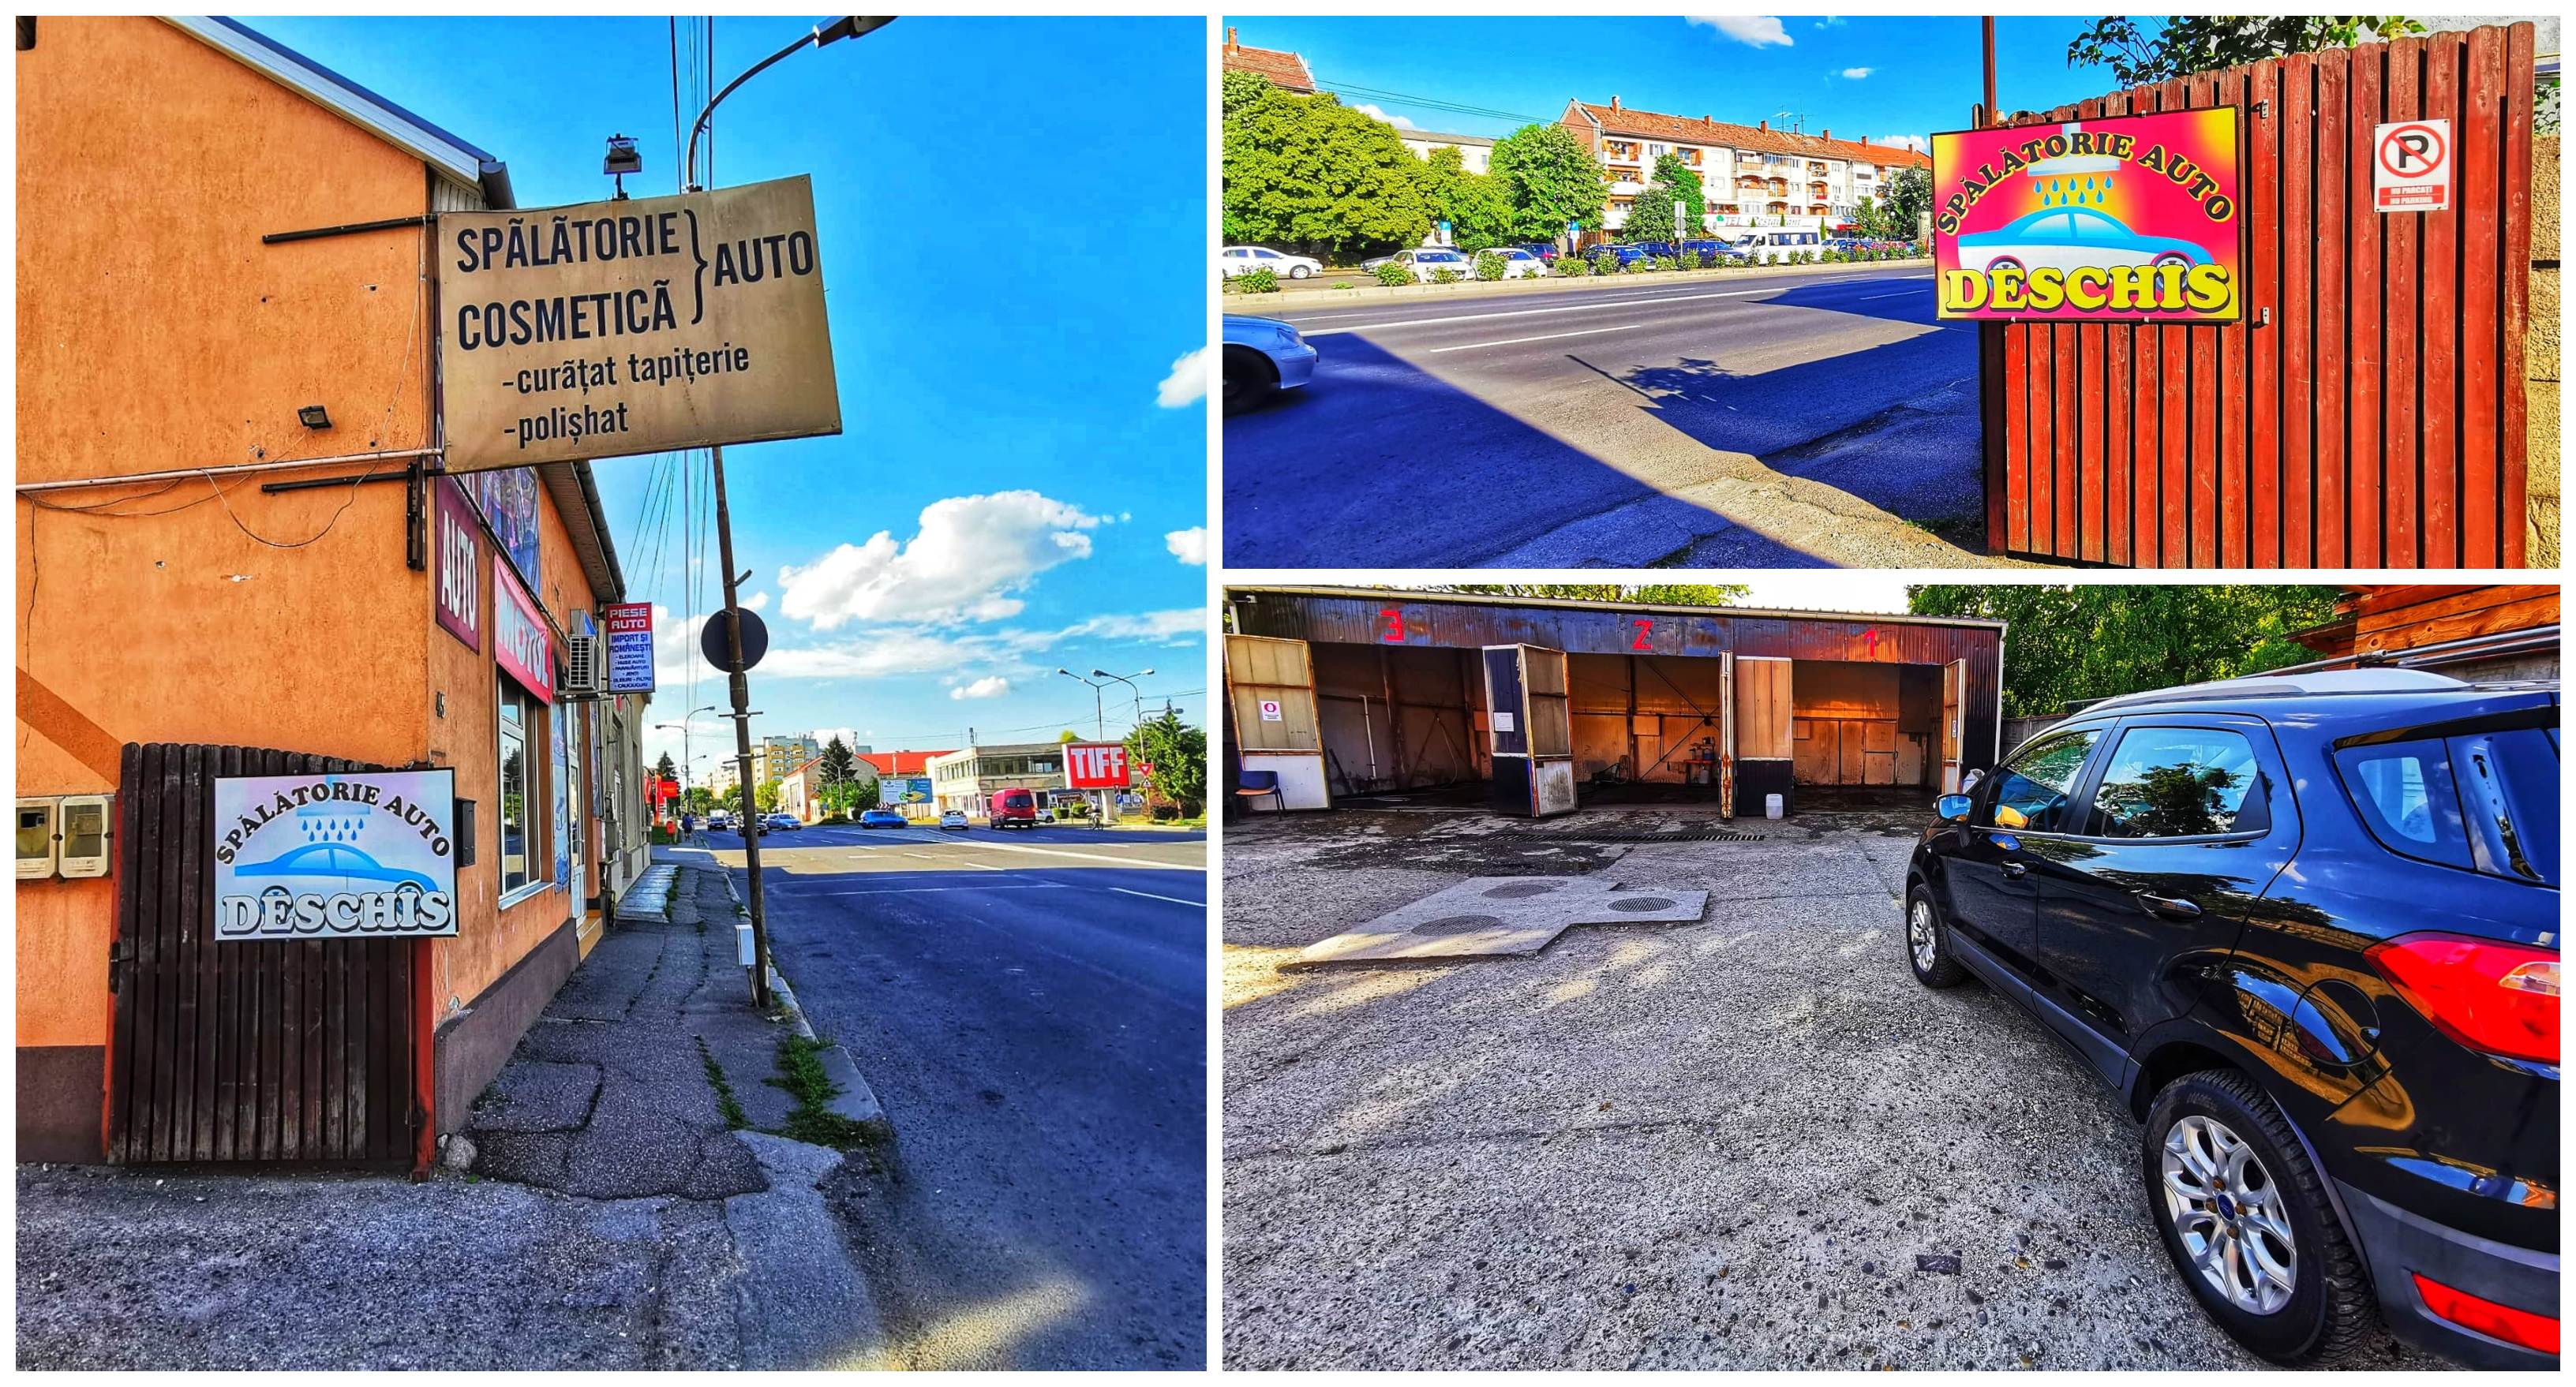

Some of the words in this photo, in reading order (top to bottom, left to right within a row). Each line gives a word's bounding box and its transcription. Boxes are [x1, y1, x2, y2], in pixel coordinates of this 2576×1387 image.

[1938, 131, 2134, 235] SPĂLĂTORIE
[2138, 144, 2233, 222] AUTO
[713, 230, 814, 287] AUTO
[1945, 264, 2230, 312] DESCHIS
[627, 342, 750, 386] tapițerie
[442, 510, 477, 631] AUTO
[609, 608, 648, 619] PIESE
[611, 619, 646, 630] AUTO
[498, 585, 549, 688] MOTUL
[612, 634, 638, 643] IMPORT
[1863, 628, 1877, 657] 1
[1070, 747, 1125, 779] TIFF
[216, 781, 381, 865] SPĂLĂTORIE
[384, 795, 450, 857] AUTO
[221, 891, 451, 935] DESCHIS
